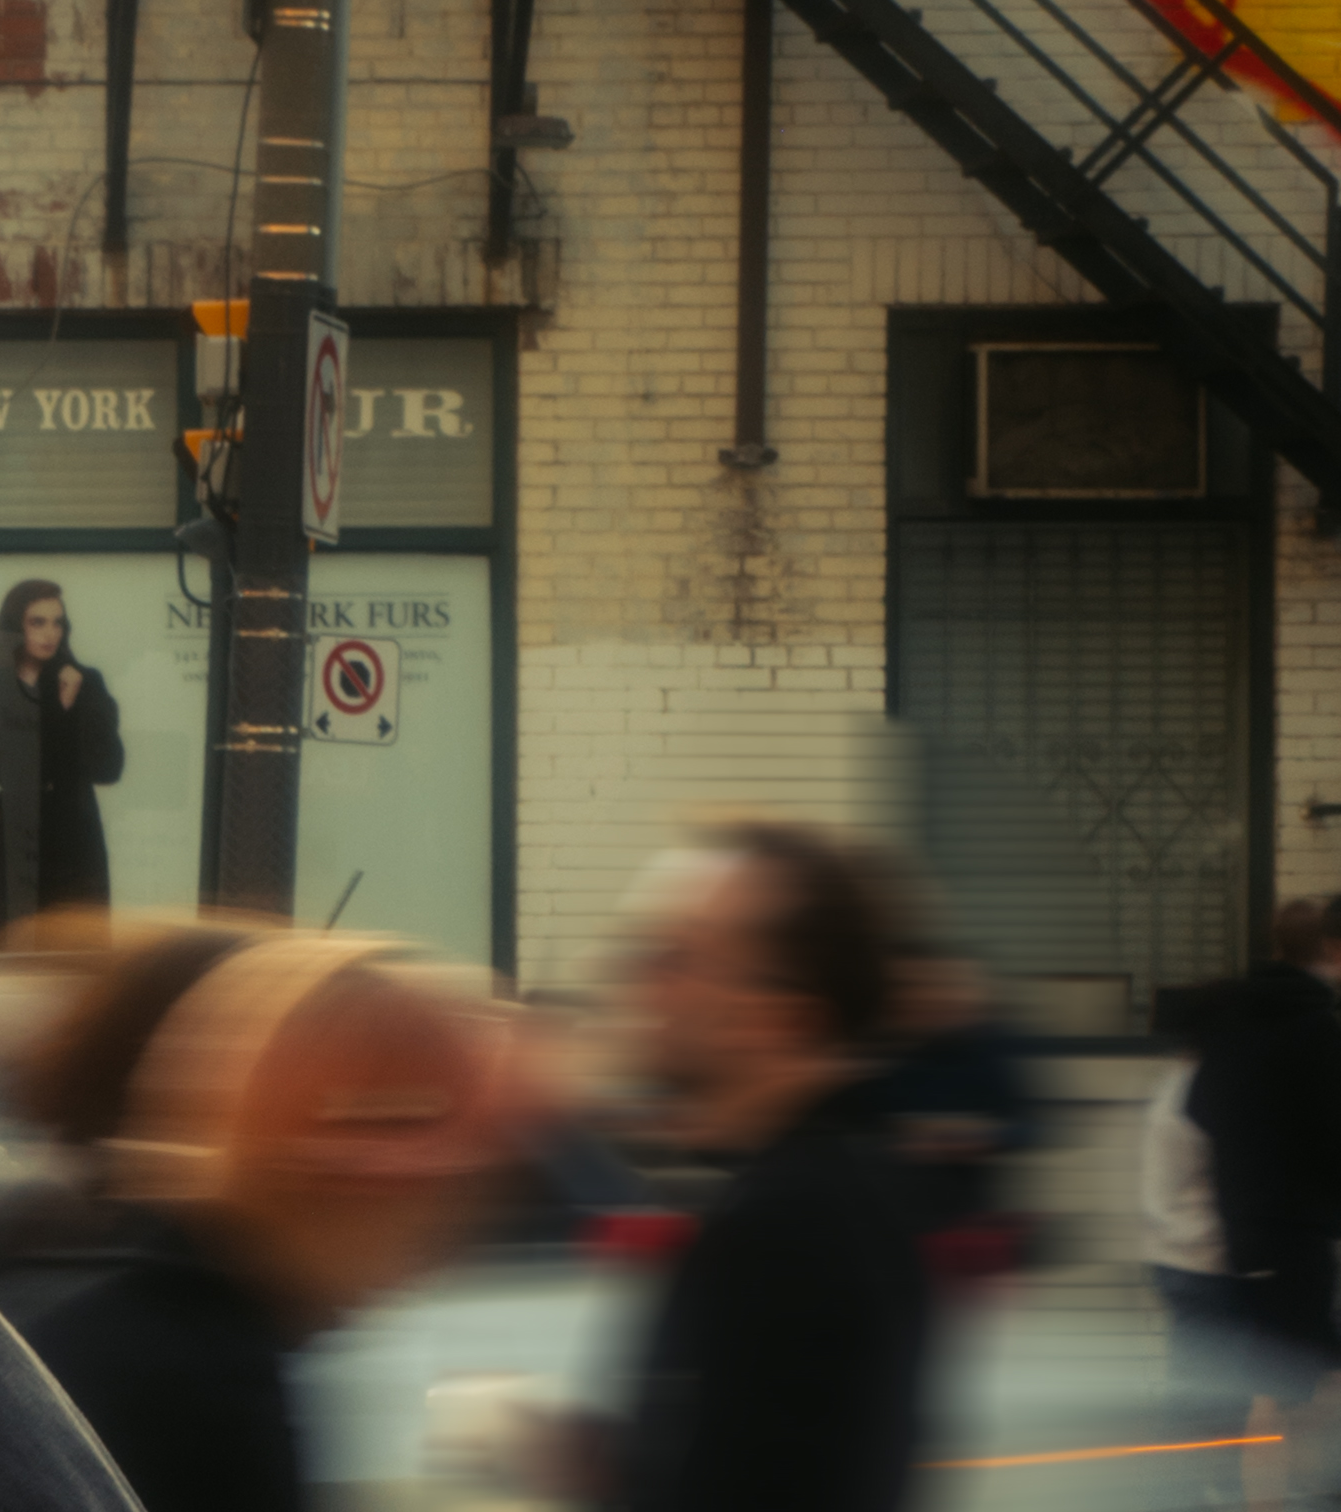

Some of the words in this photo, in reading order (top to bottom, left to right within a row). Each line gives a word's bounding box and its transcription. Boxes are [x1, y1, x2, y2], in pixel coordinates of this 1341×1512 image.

[33, 388, 156, 432] YORK
[165, 598, 211, 630] NE
[367, 599, 451, 629] FURS
